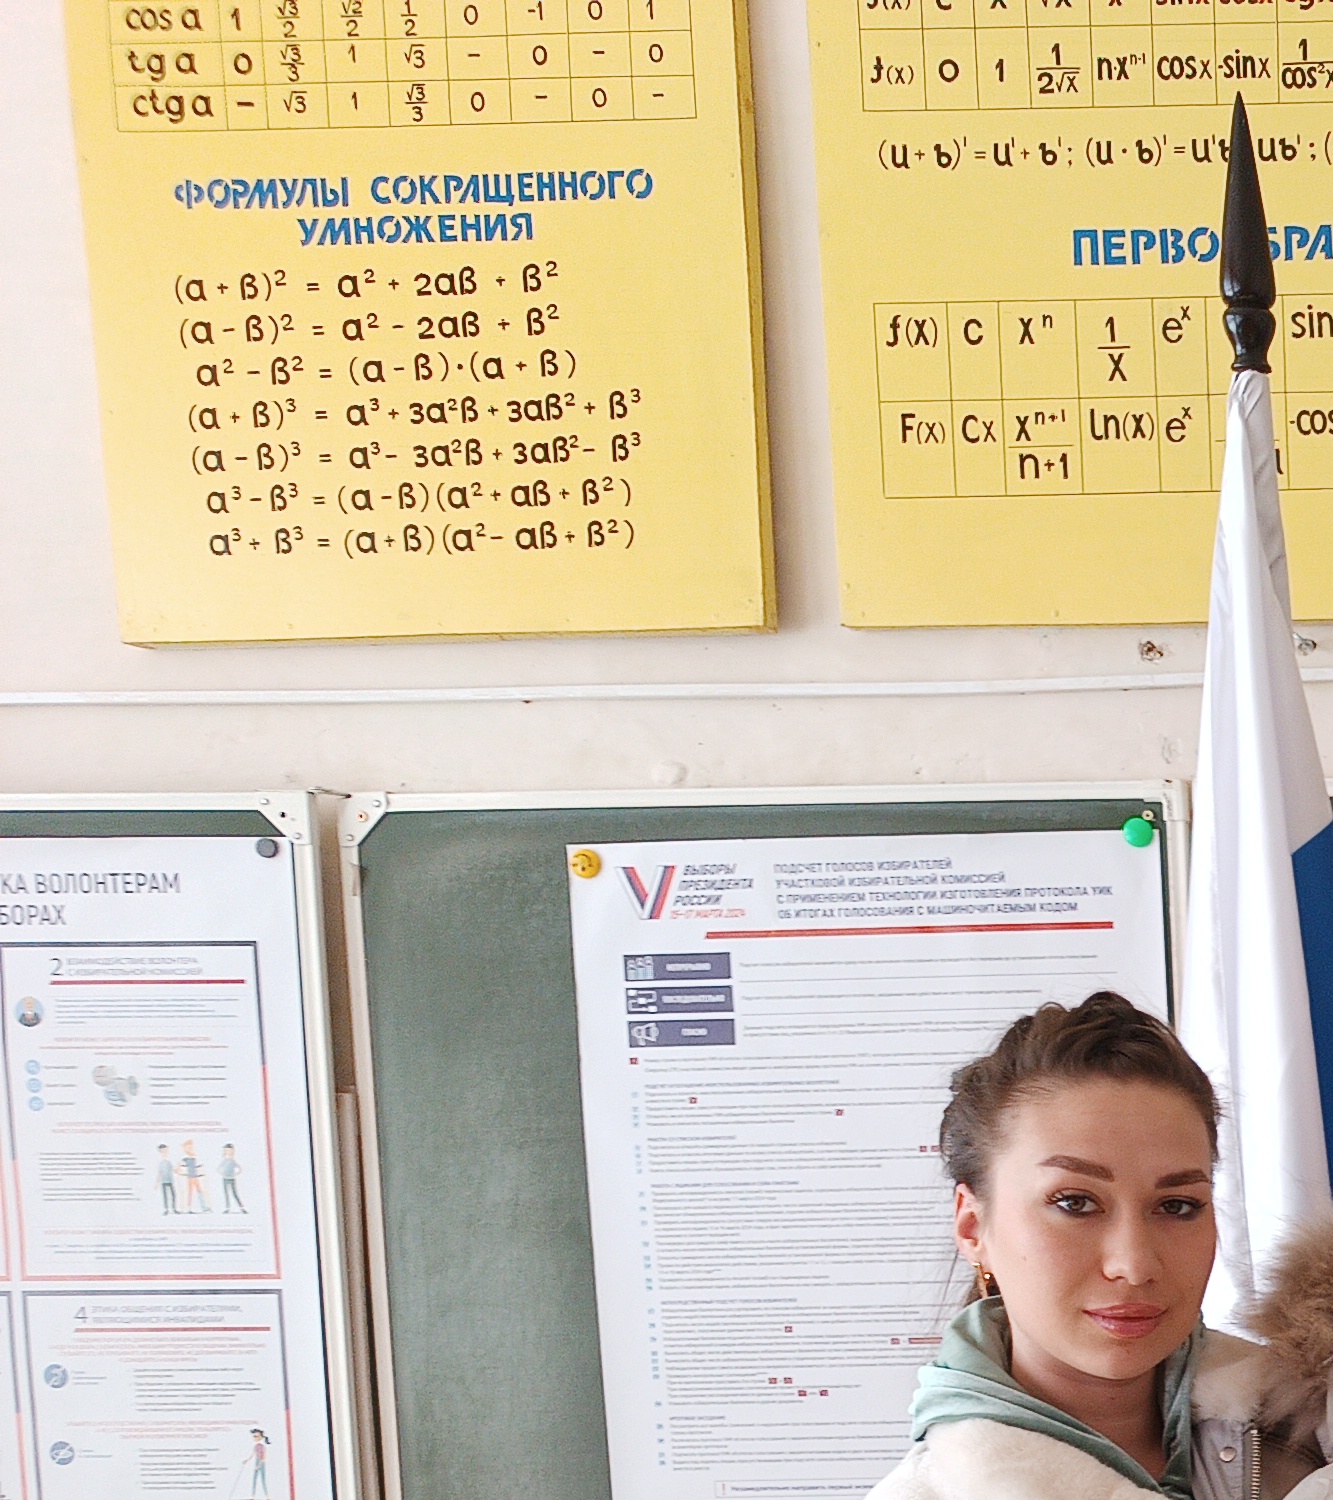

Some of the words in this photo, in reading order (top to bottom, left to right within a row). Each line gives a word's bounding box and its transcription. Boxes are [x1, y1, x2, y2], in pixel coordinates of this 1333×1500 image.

[174, 176, 349, 210] ФОРМУЛЫ
[370, 168, 653, 207] СОКРАЩЕННОГО
[296, 212, 534, 247] УМНОЖЕНИЯ
[825, 862, 873, 872] ГОЛОСОВ
[877, 858, 952, 871] ИЗБИРАТЕЛЕЙ
[34, 872, 182, 894] ВОЛОНТЕРАМ
[678, 879, 754, 891] ПРЕЗИДЕНТА
[941, 871, 1005, 884] КОМИССИЕЙ
[1024, 887, 1088, 898] ПРОТОКОЛА
[50, 957, 64, 976] 2
